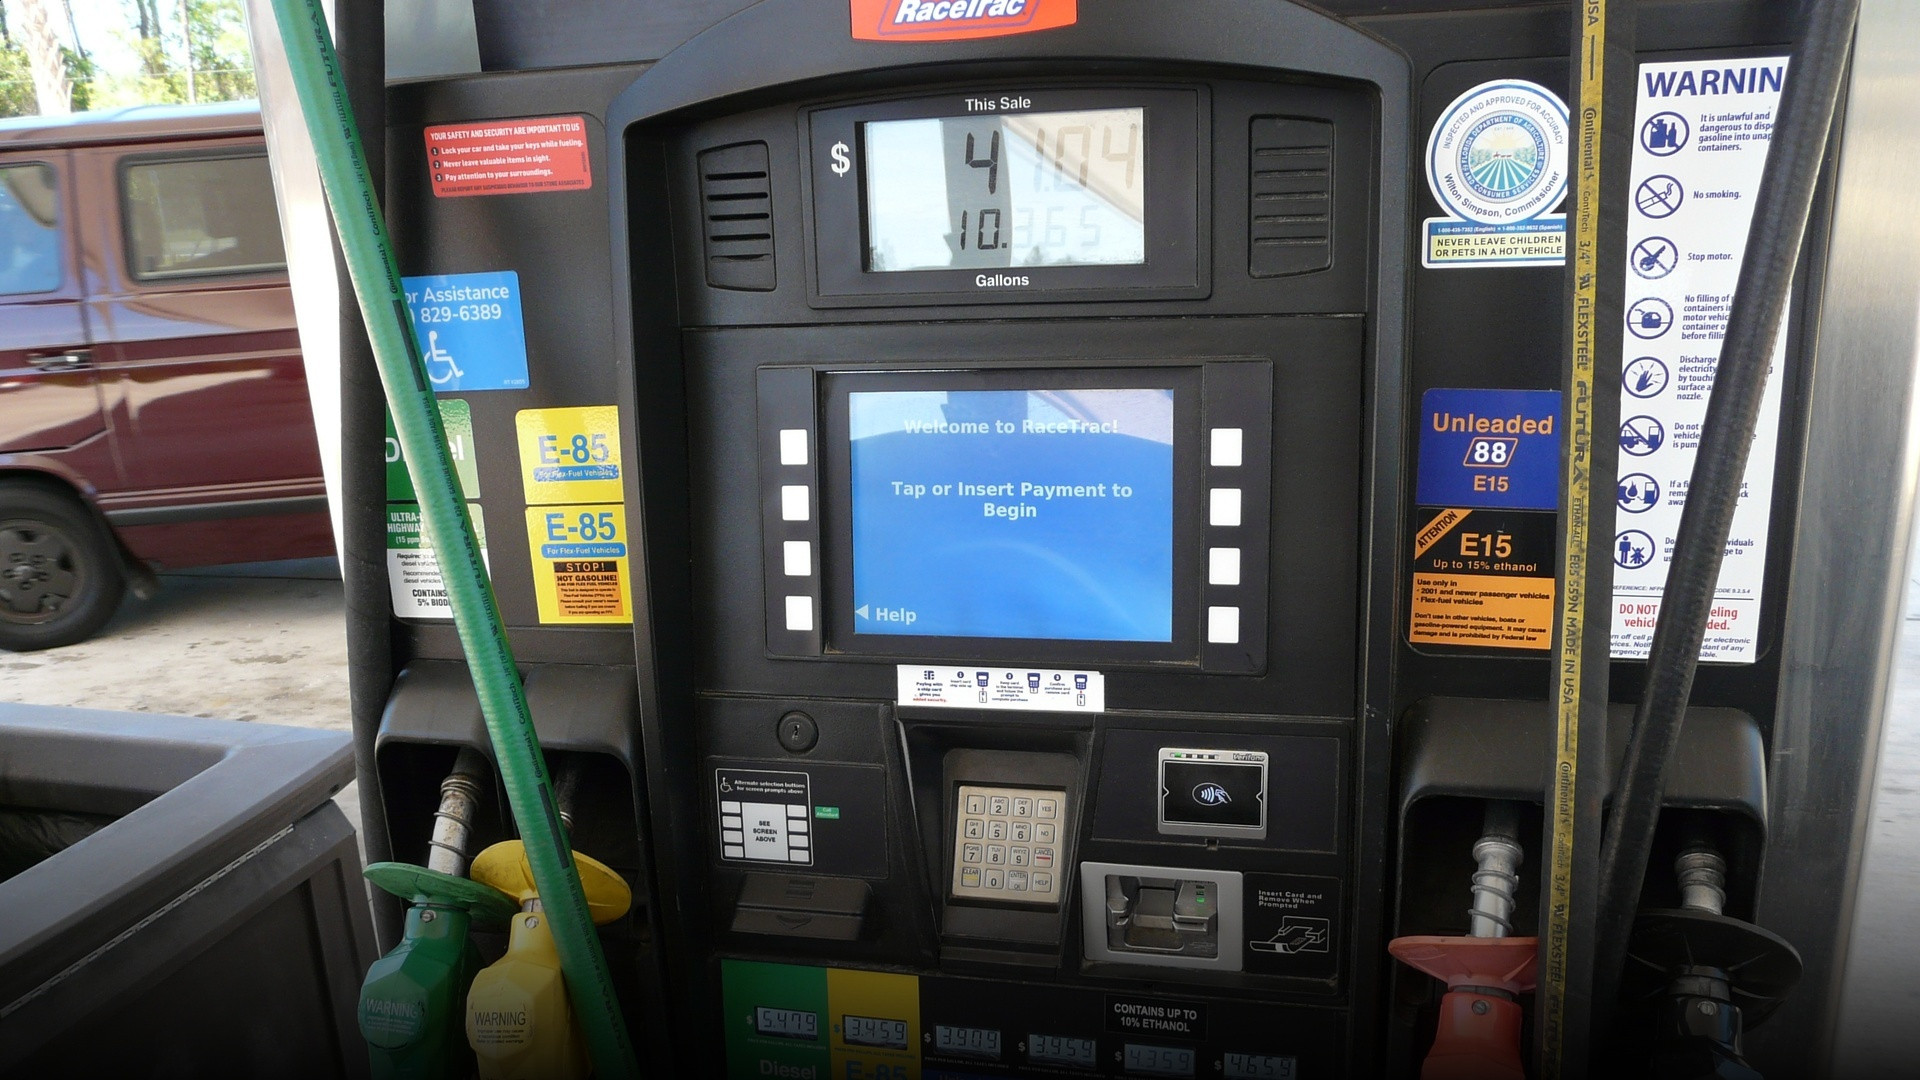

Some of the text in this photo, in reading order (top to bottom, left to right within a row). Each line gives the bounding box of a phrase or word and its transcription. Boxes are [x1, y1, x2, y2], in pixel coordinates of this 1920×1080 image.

[1645, 66, 1783, 97] WARNIN
[965, 96, 1031, 111] This Sale
[1443, 96, 1564, 149] INSPECTED AND APPROVED FOR ACCURACY
[1717, 111, 1770, 121] unlawful and
[447, 130, 469, 139] SAFETY
[484, 128, 512, 137] SECURITY
[514, 126, 526, 135] ARE
[527, 124, 561, 133] IMPORTANT
[1700, 124, 1742, 133] dangerous
[559, 139, 583, 147] fueling.
[1473, 116, 1545, 162] DEPARTMENT AGRICULTURE
[1699, 133, 1732, 143] gasoline
[1698, 144, 1742, 152] containers.
[533, 155, 550, 163] sight.
[831, 141, 850, 177] $
[510, 168, 553, 177] surroundings.
[1512, 169, 1540, 195] SERVICES
[1444, 172, 1560, 218] Wilton Simpson, Commissioner
[1693, 190, 1742, 200] No smoking.
[365, 190, 380, 236] ContiTech
[960, 204, 1100, 250] 10.365
[1510, 236, 1561, 244] CHILDREN
[1500, 247, 1518, 255] HOT
[1687, 252, 1705, 262] Stop
[380, 252, 398, 294] Continental
[976, 274, 1029, 288] Gallons
[424, 286, 509, 303] Assistance
[1697, 294, 1719, 304] filling
[421, 304, 501, 323] 829-6389
[1680, 356, 1717, 365] Discharge
[1678, 375, 1687, 383] by
[1563, 108, 1597, 704] Continental ContiTech FUTURA E85 559N MADE IN USA
[904, 420, 1118, 434] Welcome to RaceTrac!
[1433, 413, 1553, 435] Unleaded
[538, 434, 609, 464] E-85
[1474, 442, 1507, 463] 88
[892, 482, 1132, 500] Tap or Insert Payment to
[1474, 475, 1509, 492] E15
[983, 503, 1037, 520] Begin
[546, 512, 616, 541] E-85
[1417, 511, 1458, 548] ATTENTION
[1460, 533, 1512, 557] E15
[566, 562, 605, 571] STOP!
[1433, 559, 1448, 570] Up
[1468, 561, 1490, 570] 15%
[1493, 562, 1536, 572] ethanol
[412, 589, 447, 597] CONTAINS
[1479, 591, 1518, 599] passenger
[876, 608, 917, 624] Help
[1620, 604, 1657, 615] DO NOT
[1557, 761, 1572, 868] Continental ContiTech
[367, 998, 417, 1018] WARNING
[1114, 1003, 1197, 1020] CONTAINS UP TO
[475, 1012, 526, 1026] WARNING
[763, 1011, 815, 1032] 5.479
[1120, 1017, 1190, 1032] 10% ETHANOL
[853, 1019, 905, 1039] 3.459
[942, 1027, 997, 1048] 3.909
[1036, 1035, 1092, 1057] 3.959
[1130, 1050, 1190, 1070] 4.359
[1231, 1055, 1290, 1076] 4.659
[760, 1059, 816, 1080] Diesel
